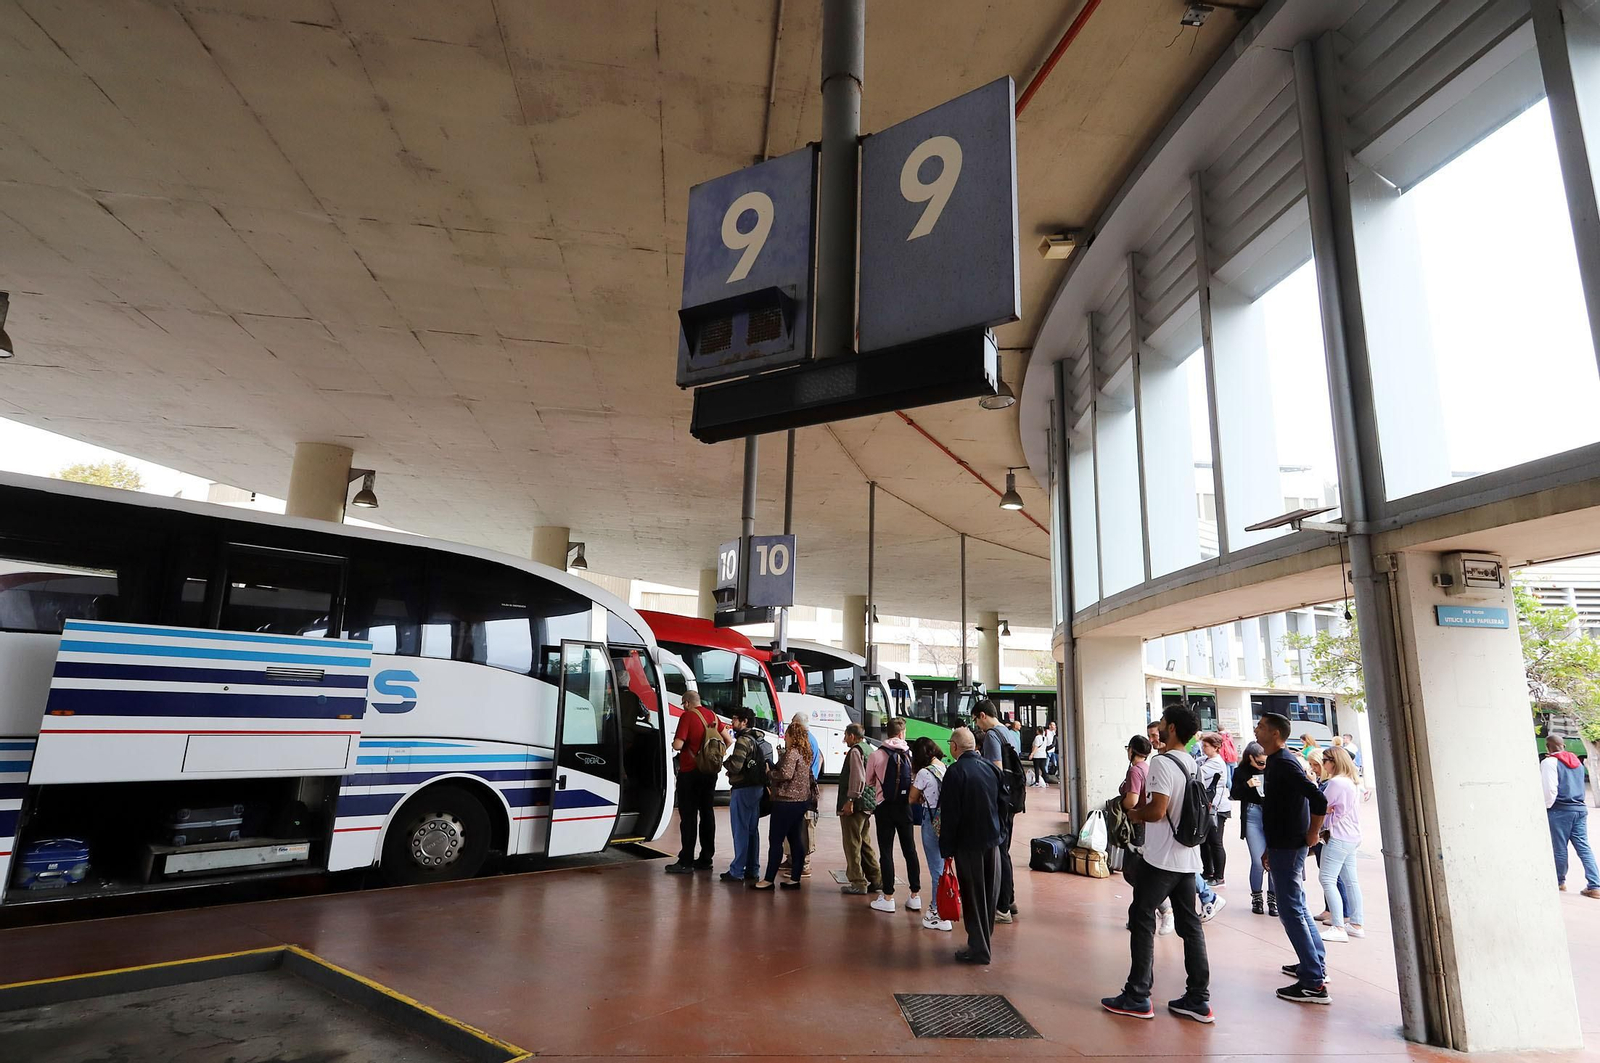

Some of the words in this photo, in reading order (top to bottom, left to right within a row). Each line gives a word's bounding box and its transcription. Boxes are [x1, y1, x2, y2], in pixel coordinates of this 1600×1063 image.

[900, 135, 963, 241] 9
[721, 191, 775, 284] 9
[721, 549, 737, 581] 10
[756, 544, 790, 576] 10
